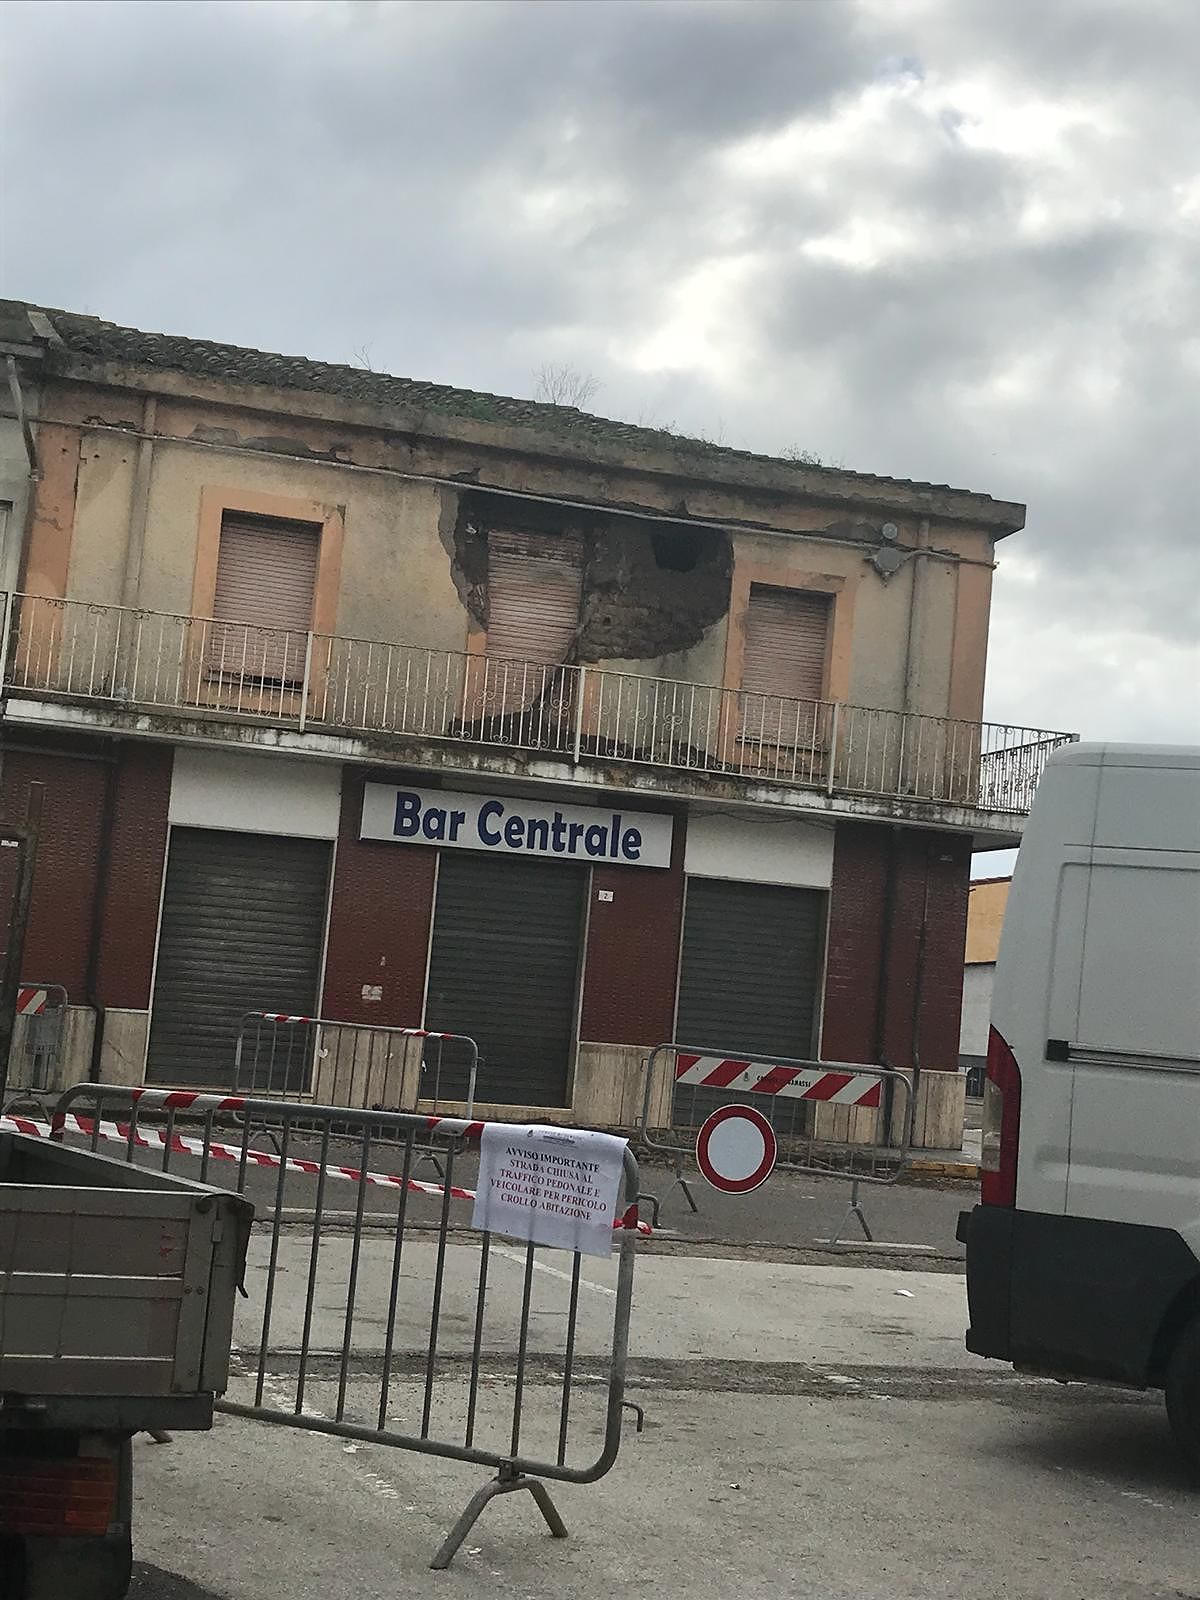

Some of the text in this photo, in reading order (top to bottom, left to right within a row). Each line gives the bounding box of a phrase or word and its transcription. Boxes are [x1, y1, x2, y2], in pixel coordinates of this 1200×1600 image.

[393, 791, 642, 860] Bar Centrale
[505, 1147, 600, 1173] AVVISO IMPORTANTE
[510, 1159, 593, 1184] STRADA CHIUSA AL
[490, 1179, 607, 1211] VEICOLARE PER PERICOLO
[500, 1169, 600, 1198] TRAFFICO PEDONALE E
[501, 1193, 592, 1221] CROLLO ABITAZIONE
